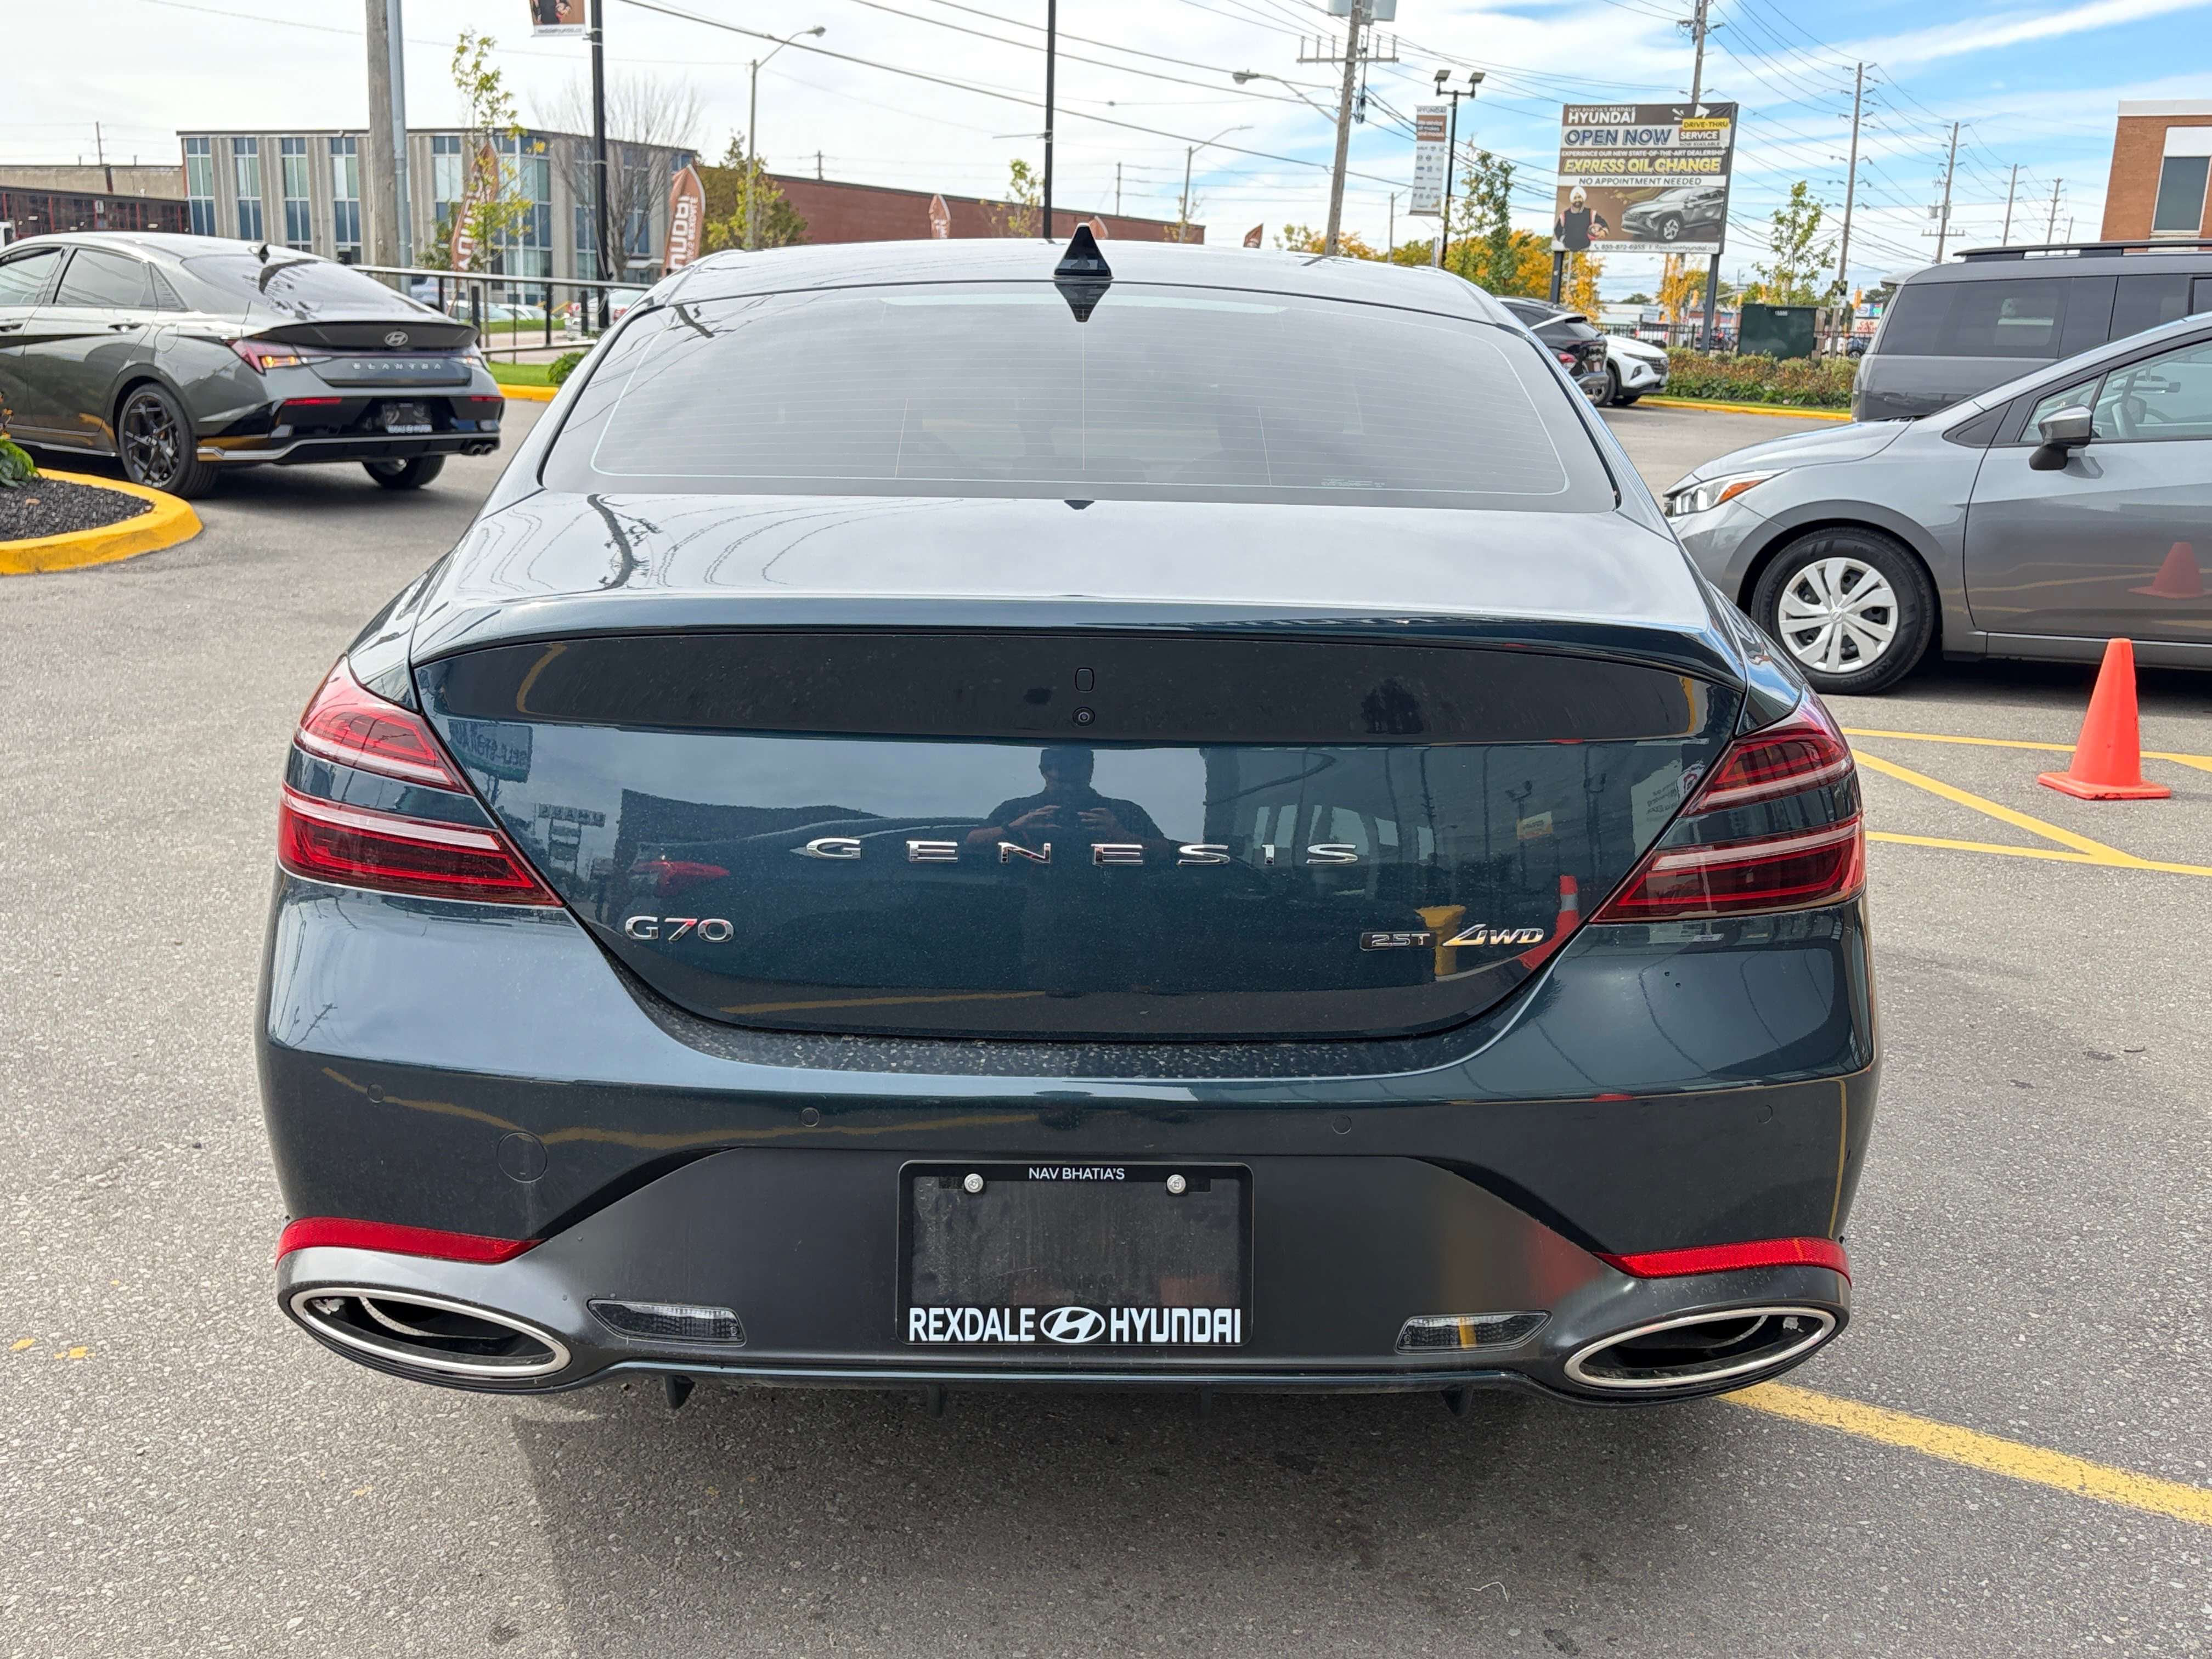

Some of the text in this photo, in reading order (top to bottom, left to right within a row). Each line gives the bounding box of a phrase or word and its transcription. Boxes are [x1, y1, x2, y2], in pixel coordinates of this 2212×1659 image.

[1568, 111, 1636, 124] HYUNDAI
[1565, 128, 1672, 146] OPEN NOW
[1680, 131, 1718, 140] SERVICE
[1563, 157, 1722, 174] EXPRESS OIL CHANGE
[805, 838, 1358, 866] GENESIS
[625, 916, 735, 943] G70
[1372, 933, 1430, 946] 2.5T
[1029, 1167, 1125, 1180] NAV BHATIA'S
[909, 1308, 1240, 1343] REXDALE HYUNDAI
